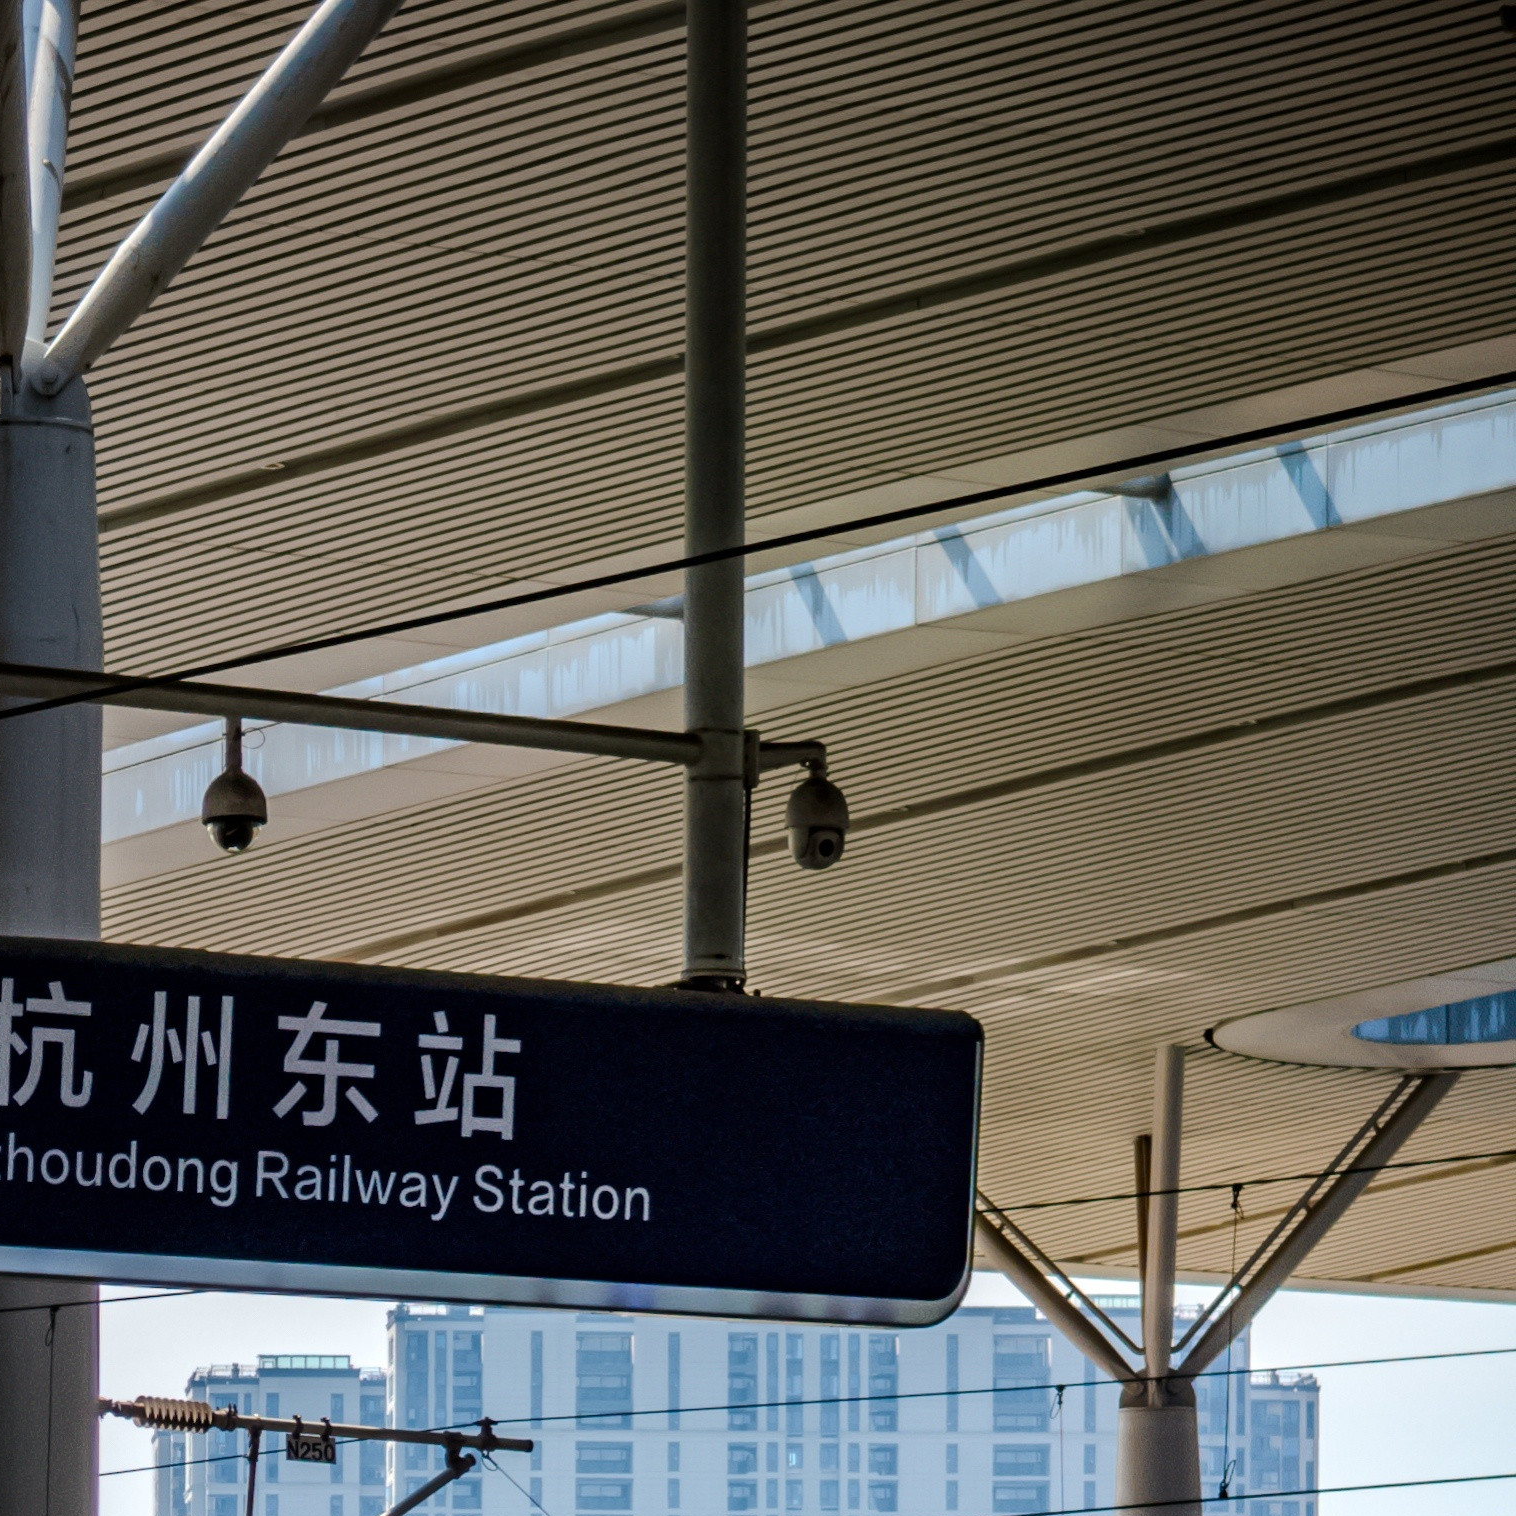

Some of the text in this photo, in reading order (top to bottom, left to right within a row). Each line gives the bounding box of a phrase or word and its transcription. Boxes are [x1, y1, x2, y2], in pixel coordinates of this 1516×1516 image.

[257, 1150, 459, 1221] Railway
[473, 1165, 650, 1221] Station
[287, 1440, 334, 1462] N250
